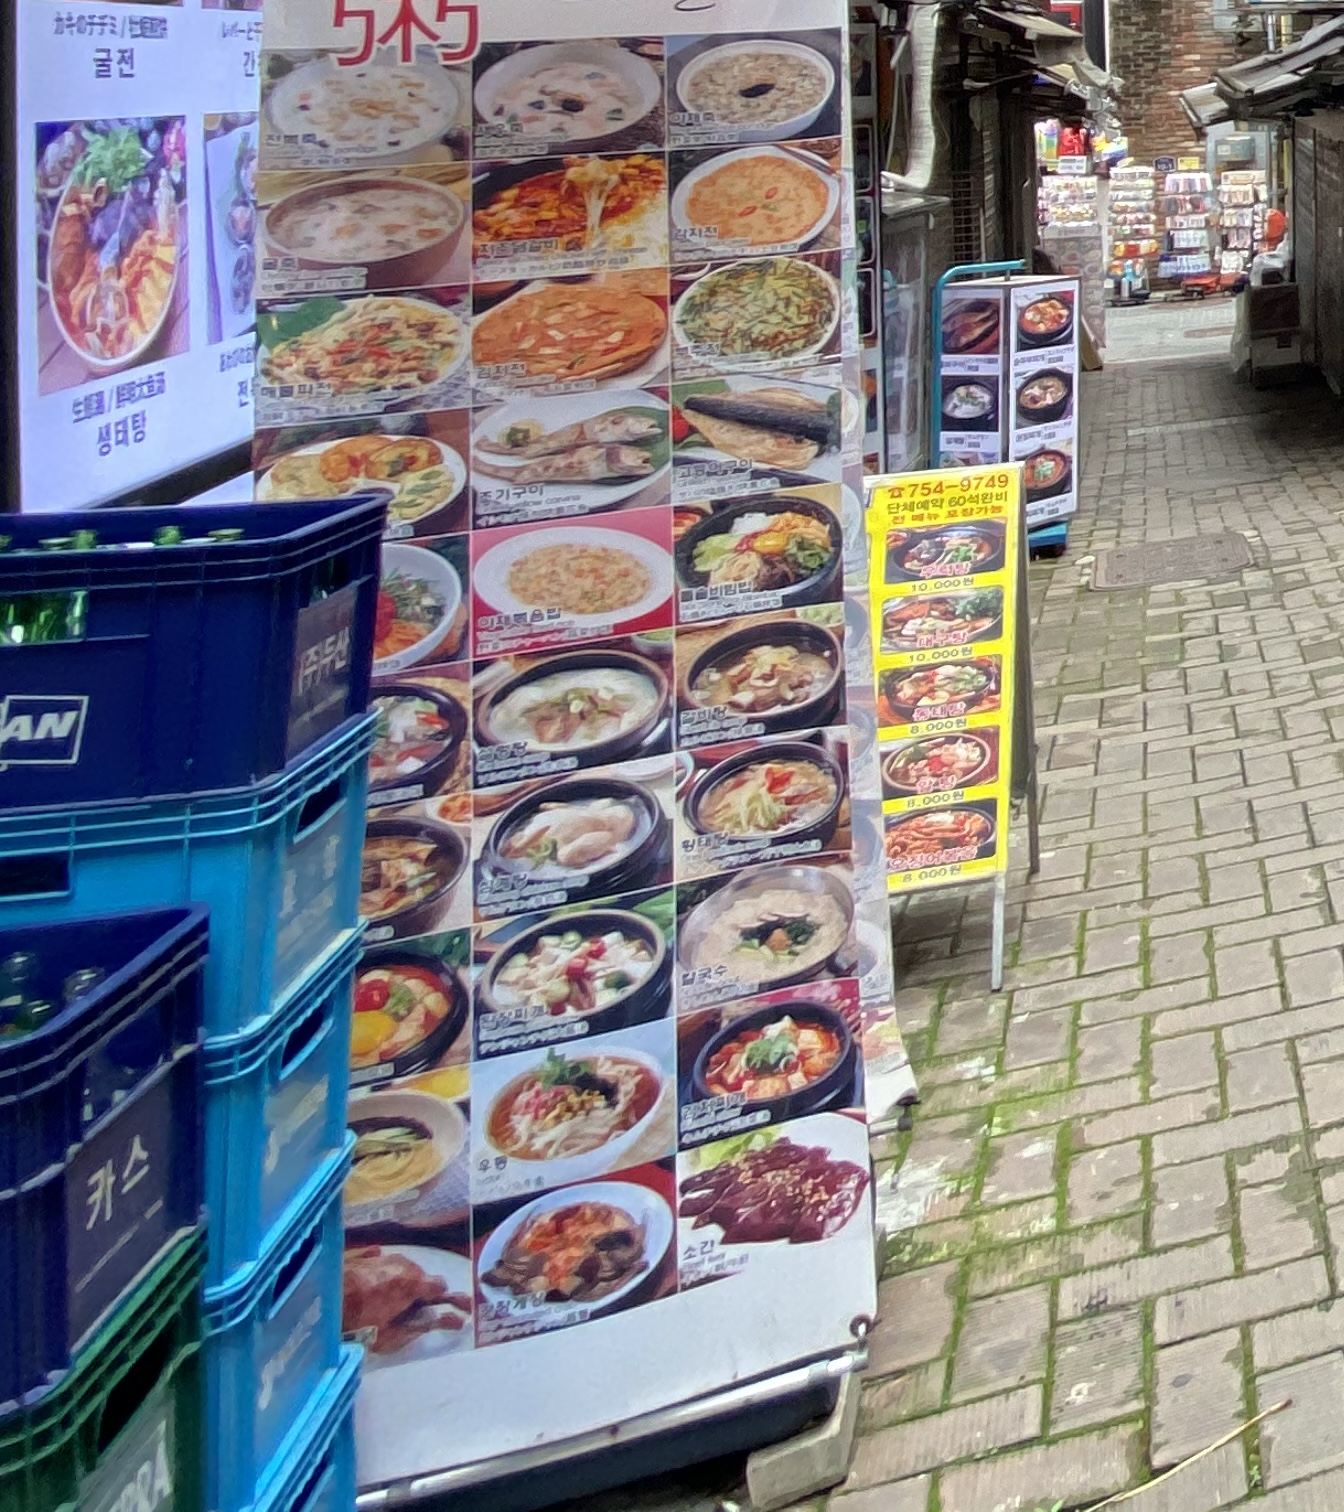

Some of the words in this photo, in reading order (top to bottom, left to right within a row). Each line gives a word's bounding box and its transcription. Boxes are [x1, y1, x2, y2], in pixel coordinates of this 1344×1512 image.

[93, 47, 135, 79] 굴전
[907, 474, 1010, 498] 754-9749
[887, 497, 945, 515] 단체예약
[947, 491, 1009, 508] 60석완비
[86, 1134, 151, 1231] 카스
